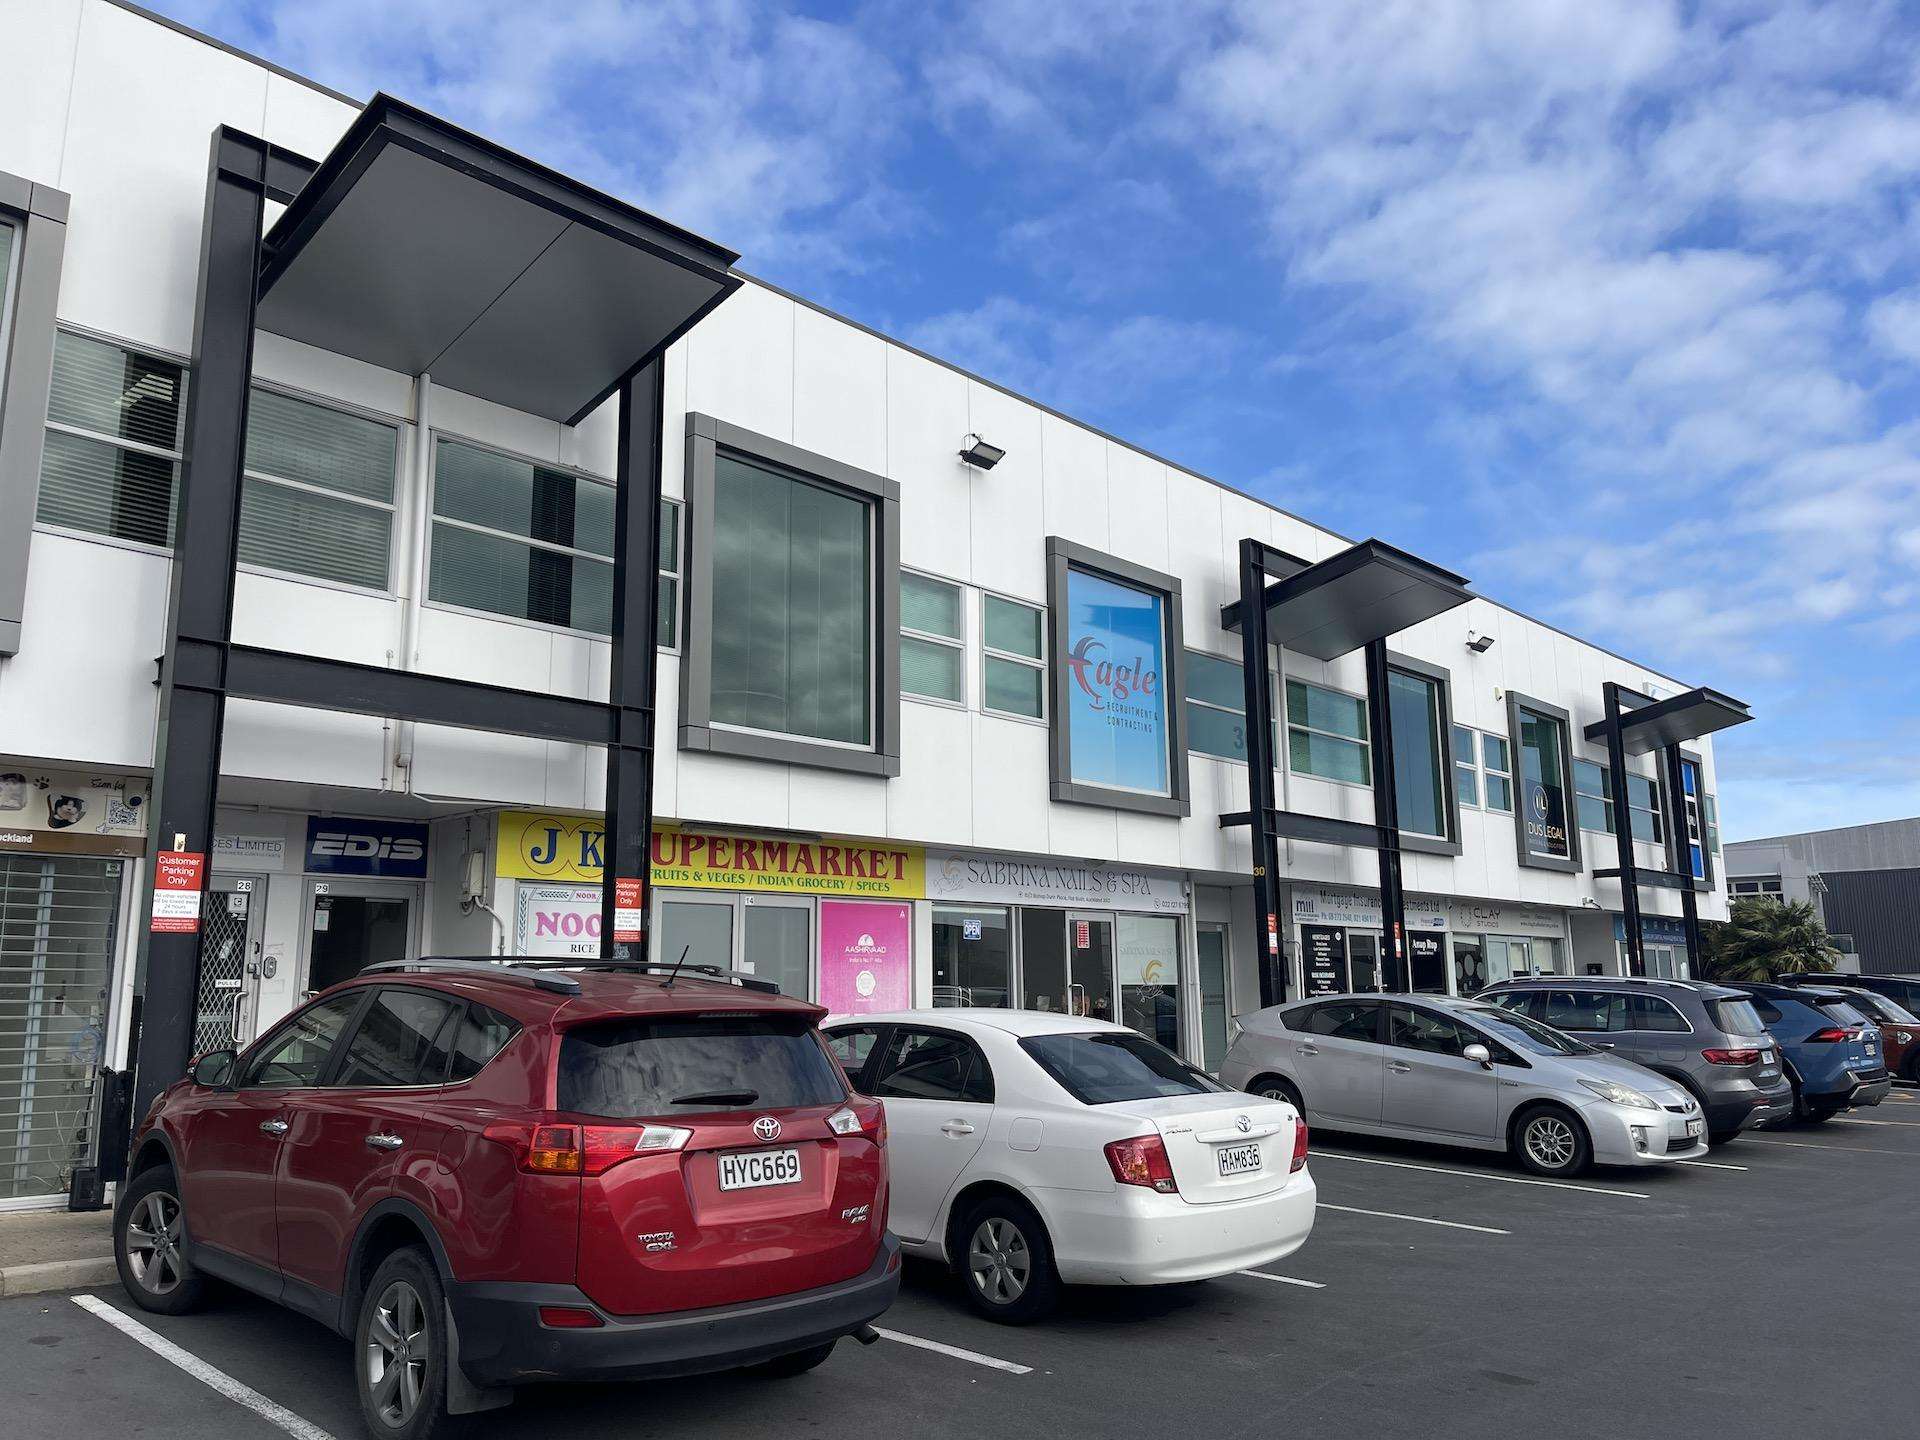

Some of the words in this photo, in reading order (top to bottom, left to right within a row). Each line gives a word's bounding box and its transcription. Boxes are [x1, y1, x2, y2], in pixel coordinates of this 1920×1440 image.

[1068, 636, 1156, 701] Eagle
[1106, 701, 1153, 719] RECRUITMENT
[1153, 711, 1158, 721] &
[1106, 716, 1153, 733] CONTRACTING
[1233, 726, 1244, 750] 3
[1528, 821, 1543, 837] DUS
[1544, 825, 1566, 841] LEGAL
[236, 836, 282, 852] LIMITED
[159, 856, 200, 865] Customer
[530, 828, 563, 865] J
[577, 830, 605, 867] K
[650, 832, 909, 881] UPERMARKET
[162, 866, 195, 876] Parking
[967, 858, 1050, 889] SABRINA
[1055, 867, 1103, 892] NAILS
[1106, 871, 1118, 893] &
[1121, 872, 1152, 896] SPA
[1253, 867, 1265, 876] 30
[167, 876, 188, 886] Only
[238, 882, 251, 891] 28
[650, 869, 689, 881] RUITS
[693, 871, 703, 881] &
[707, 872, 745, 884] VEGES
[757, 875, 794, 887] INDIAN
[797, 877, 846, 889] GROCERY
[856, 881, 890, 892] SPICES
[316, 885, 328, 893] 29
[620, 897, 634, 905] Only
[745, 897, 754, 905] 14
[1320, 890, 1352, 910] Mortgage
[1353, 891, 1382, 909] Insuranc
[1403, 899, 1430, 912] estments
[1473, 906, 1502, 919] CLAY
[534, 911, 602, 937] NOO
[964, 923, 981, 935] OPEN
[570, 944, 595, 953] RICE
[1220, 1148, 1260, 1172] HAM836
[723, 1155, 798, 1185] HYC669
[638, 1231, 676, 1243] TOYOTA
